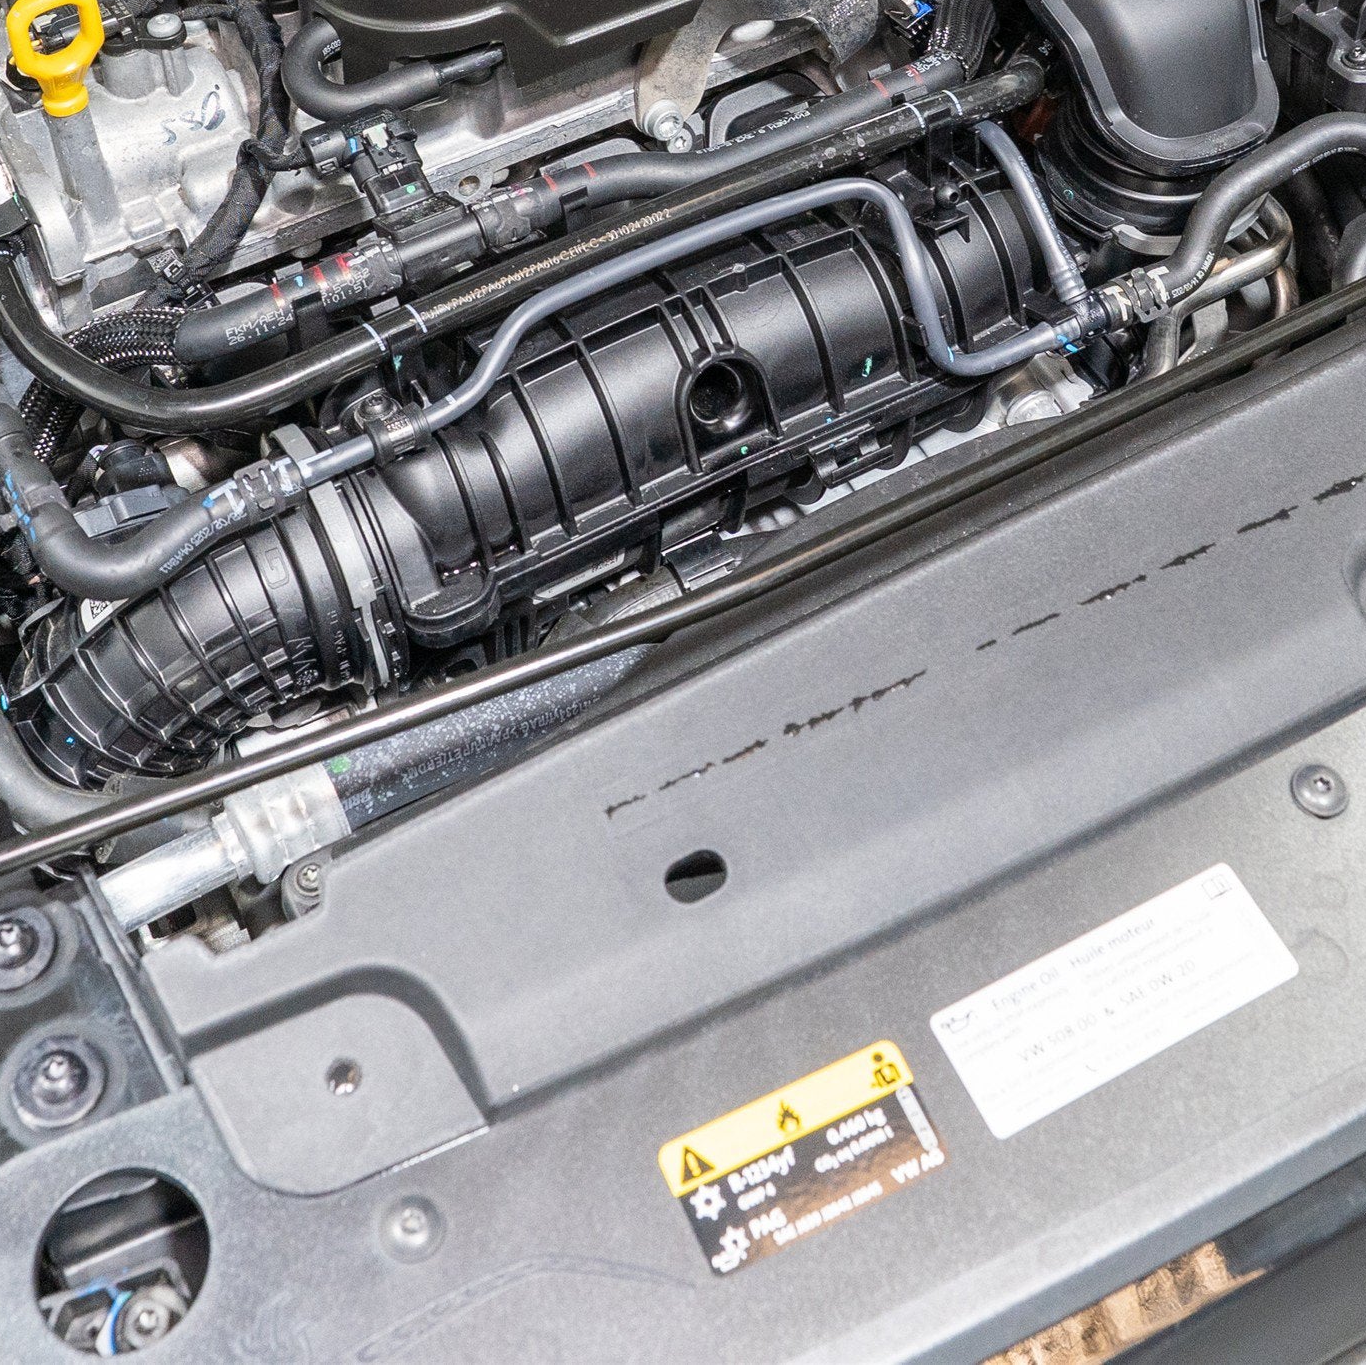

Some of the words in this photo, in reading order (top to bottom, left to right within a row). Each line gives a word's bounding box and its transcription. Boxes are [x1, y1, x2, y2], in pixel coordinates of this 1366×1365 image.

[225, 307, 283, 337] FKM/AEM
[227, 312, 293, 345] 26.11.24
[1039, 967, 1059, 985] Oil
[1070, 945, 1104, 969] Huile
[1108, 919, 1155, 948] moteur
[890, 1158, 920, 1184] VW
